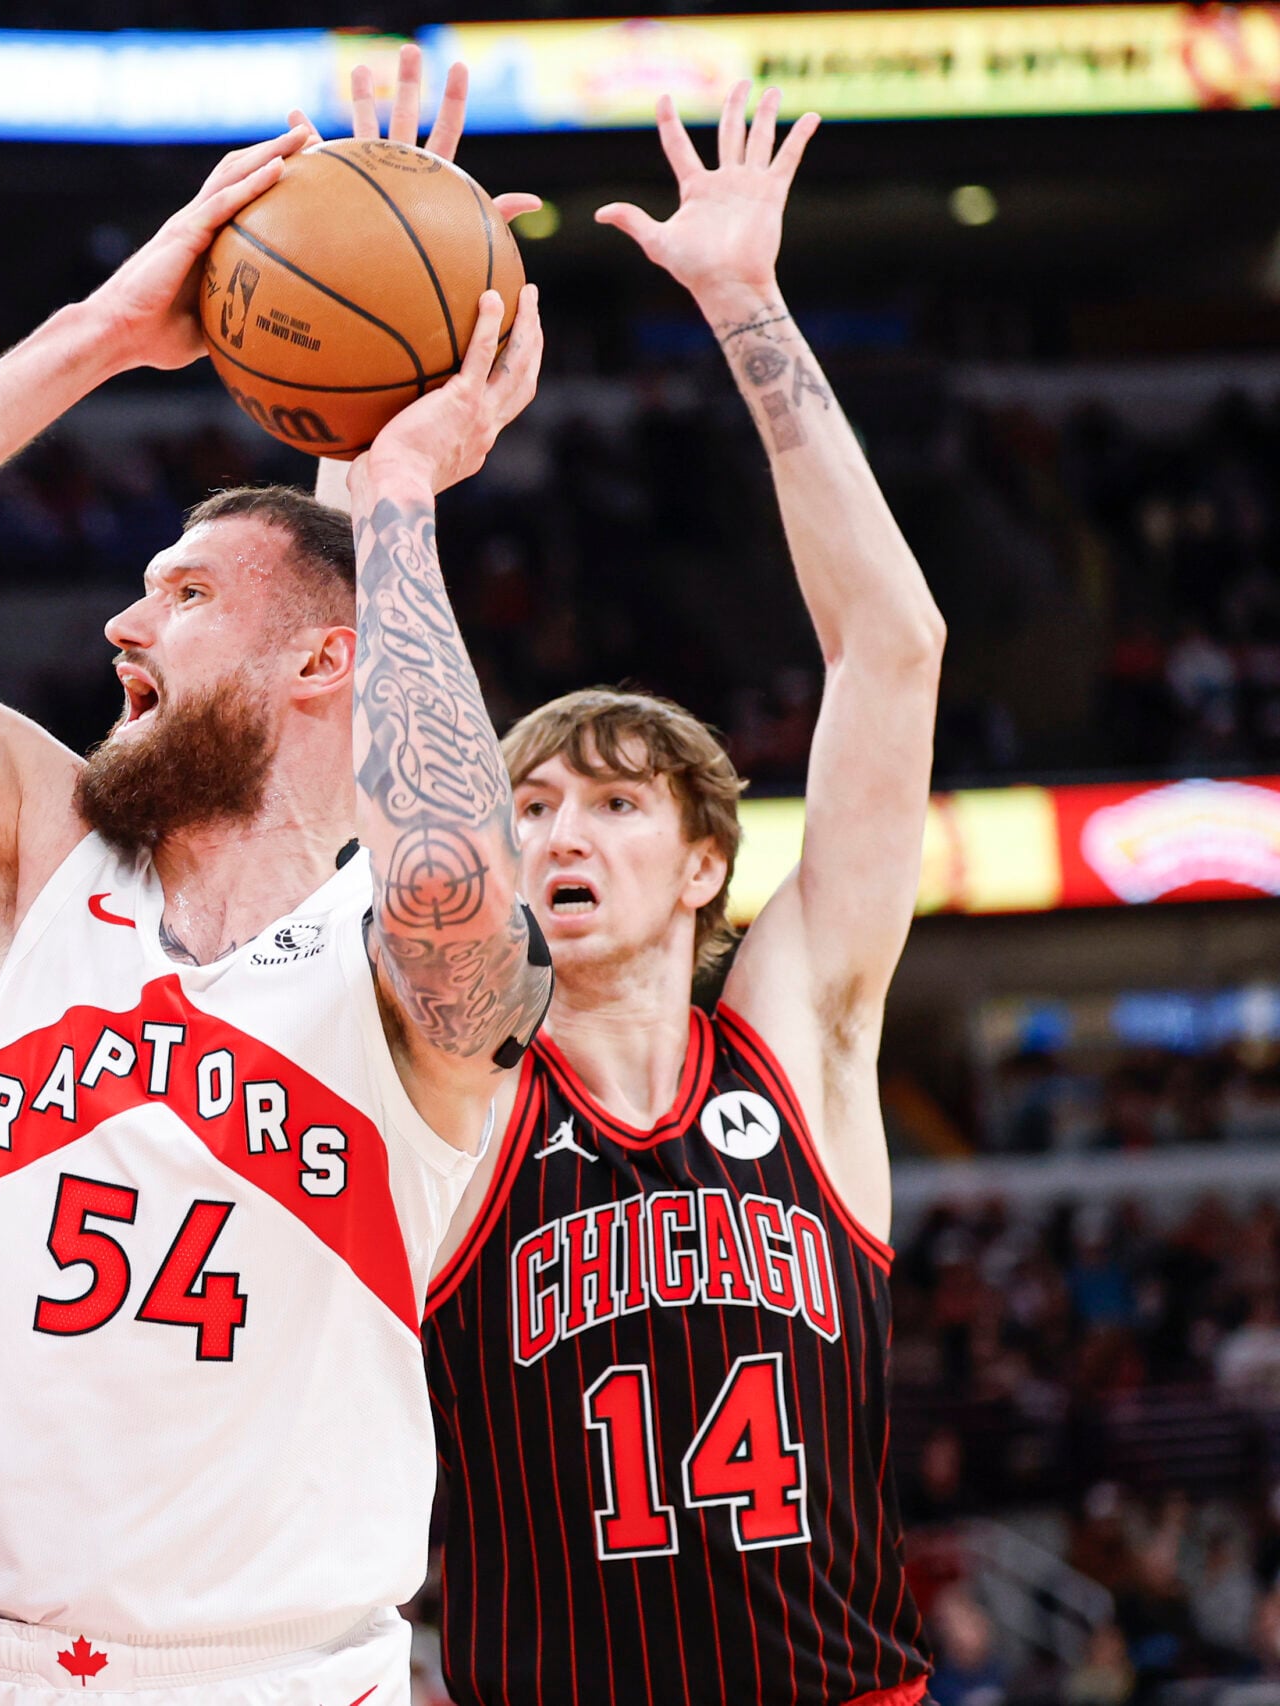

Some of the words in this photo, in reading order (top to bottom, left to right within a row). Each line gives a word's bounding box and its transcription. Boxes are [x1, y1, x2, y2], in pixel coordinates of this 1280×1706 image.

[250, 953, 288, 966] Sun
[293, 944, 325, 962] Life
[33, 1172, 249, 1362] 54
[510, 1188, 841, 1367] CHICAGO
[584, 1352, 812, 1561] 14
